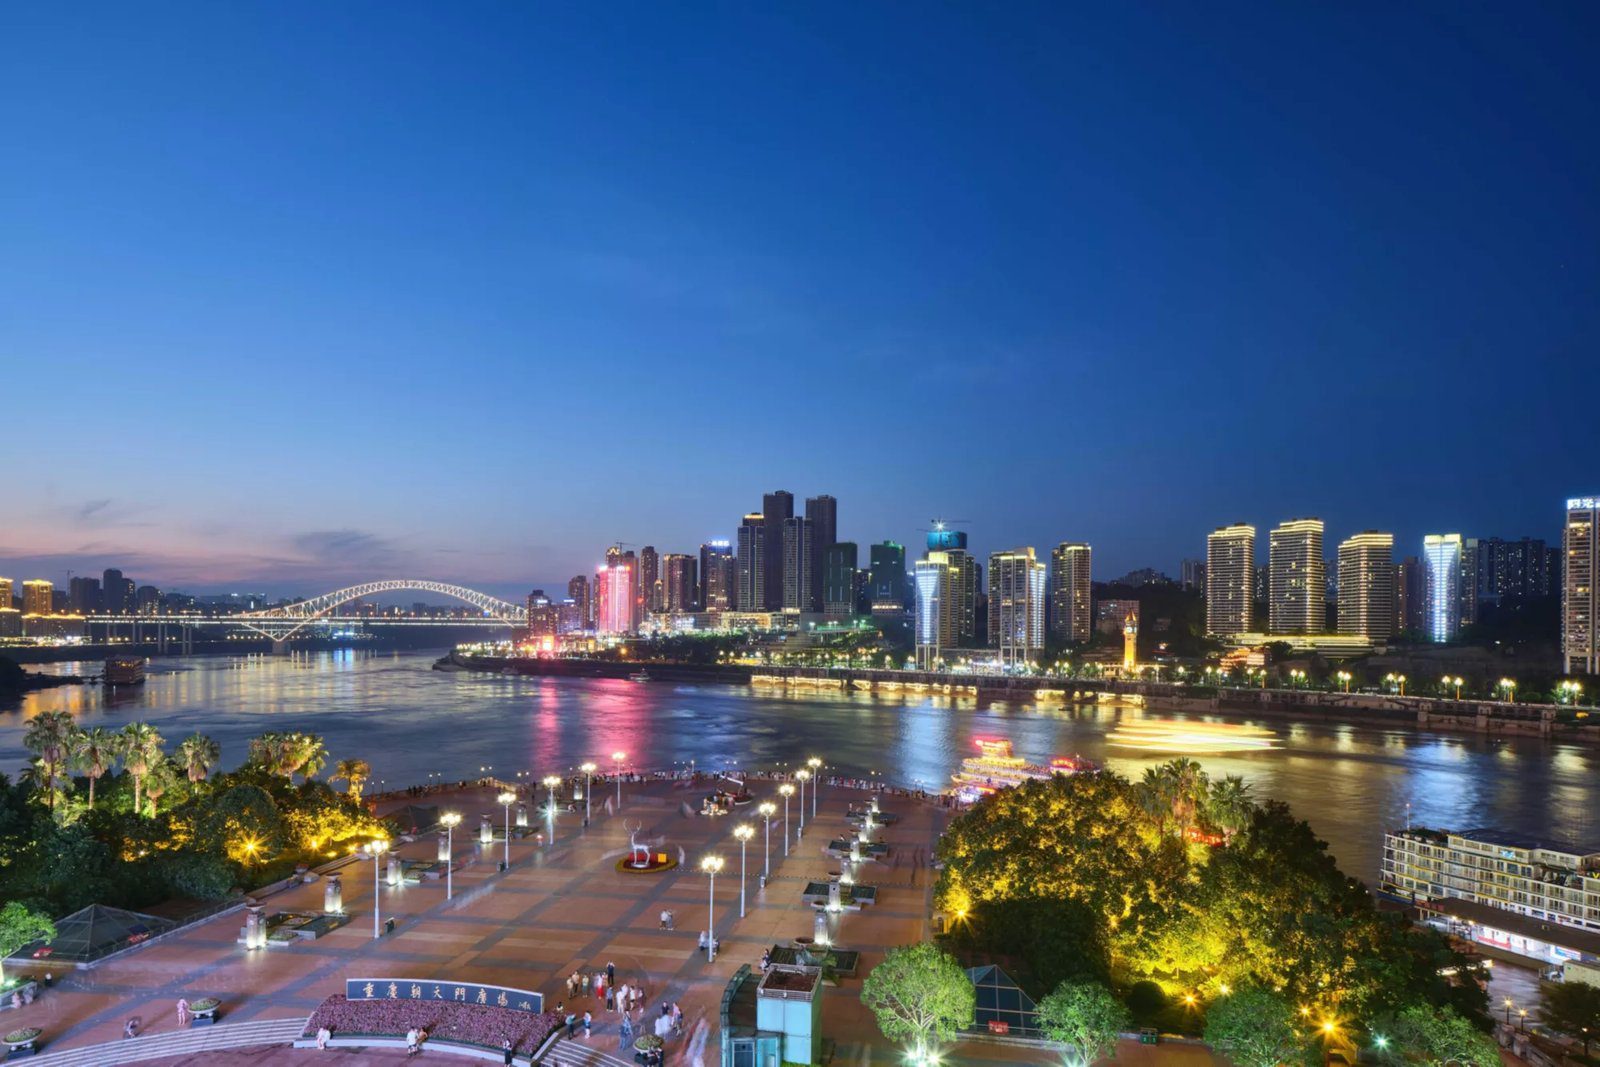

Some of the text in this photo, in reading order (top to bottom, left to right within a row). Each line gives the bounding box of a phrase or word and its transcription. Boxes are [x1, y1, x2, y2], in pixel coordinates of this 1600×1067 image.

[362, 981, 508, 1007] 重慶朝天門廣場
